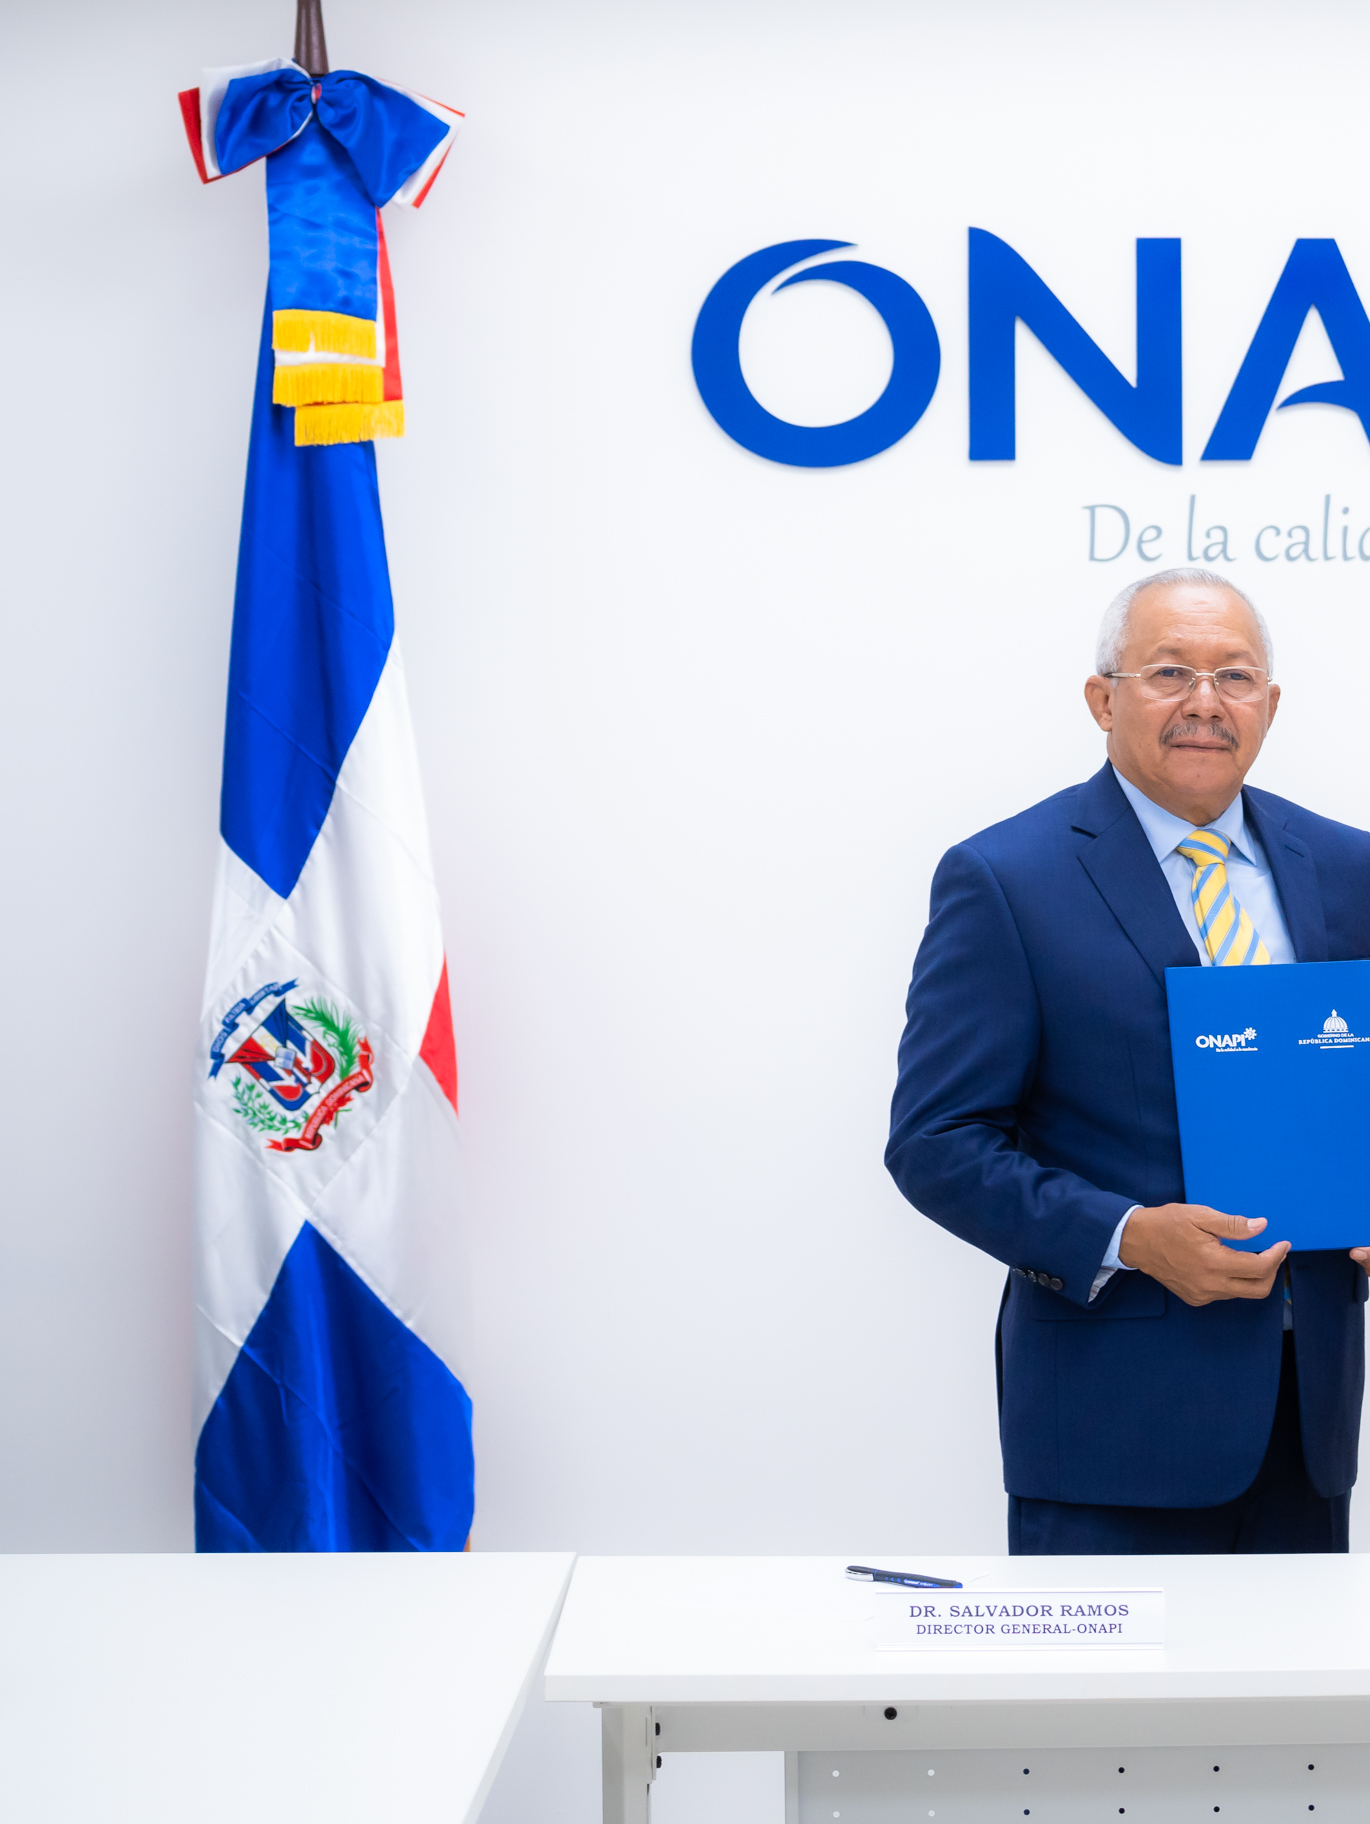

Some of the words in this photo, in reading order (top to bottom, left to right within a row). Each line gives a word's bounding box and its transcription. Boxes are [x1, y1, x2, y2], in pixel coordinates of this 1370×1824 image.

[1082, 504, 1163, 562] De
[1186, 494, 1237, 562] la
[1195, 1034, 1246, 1048] ONAPI
[909, 1605, 942, 1618] DR.
[949, 1605, 1053, 1618] SALVADOR
[1060, 1604, 1129, 1617] RAMOS
[916, 1624, 996, 1635] DIRECTOR
[1000, 1623, 1123, 1635] GENERAL-ONAPI
